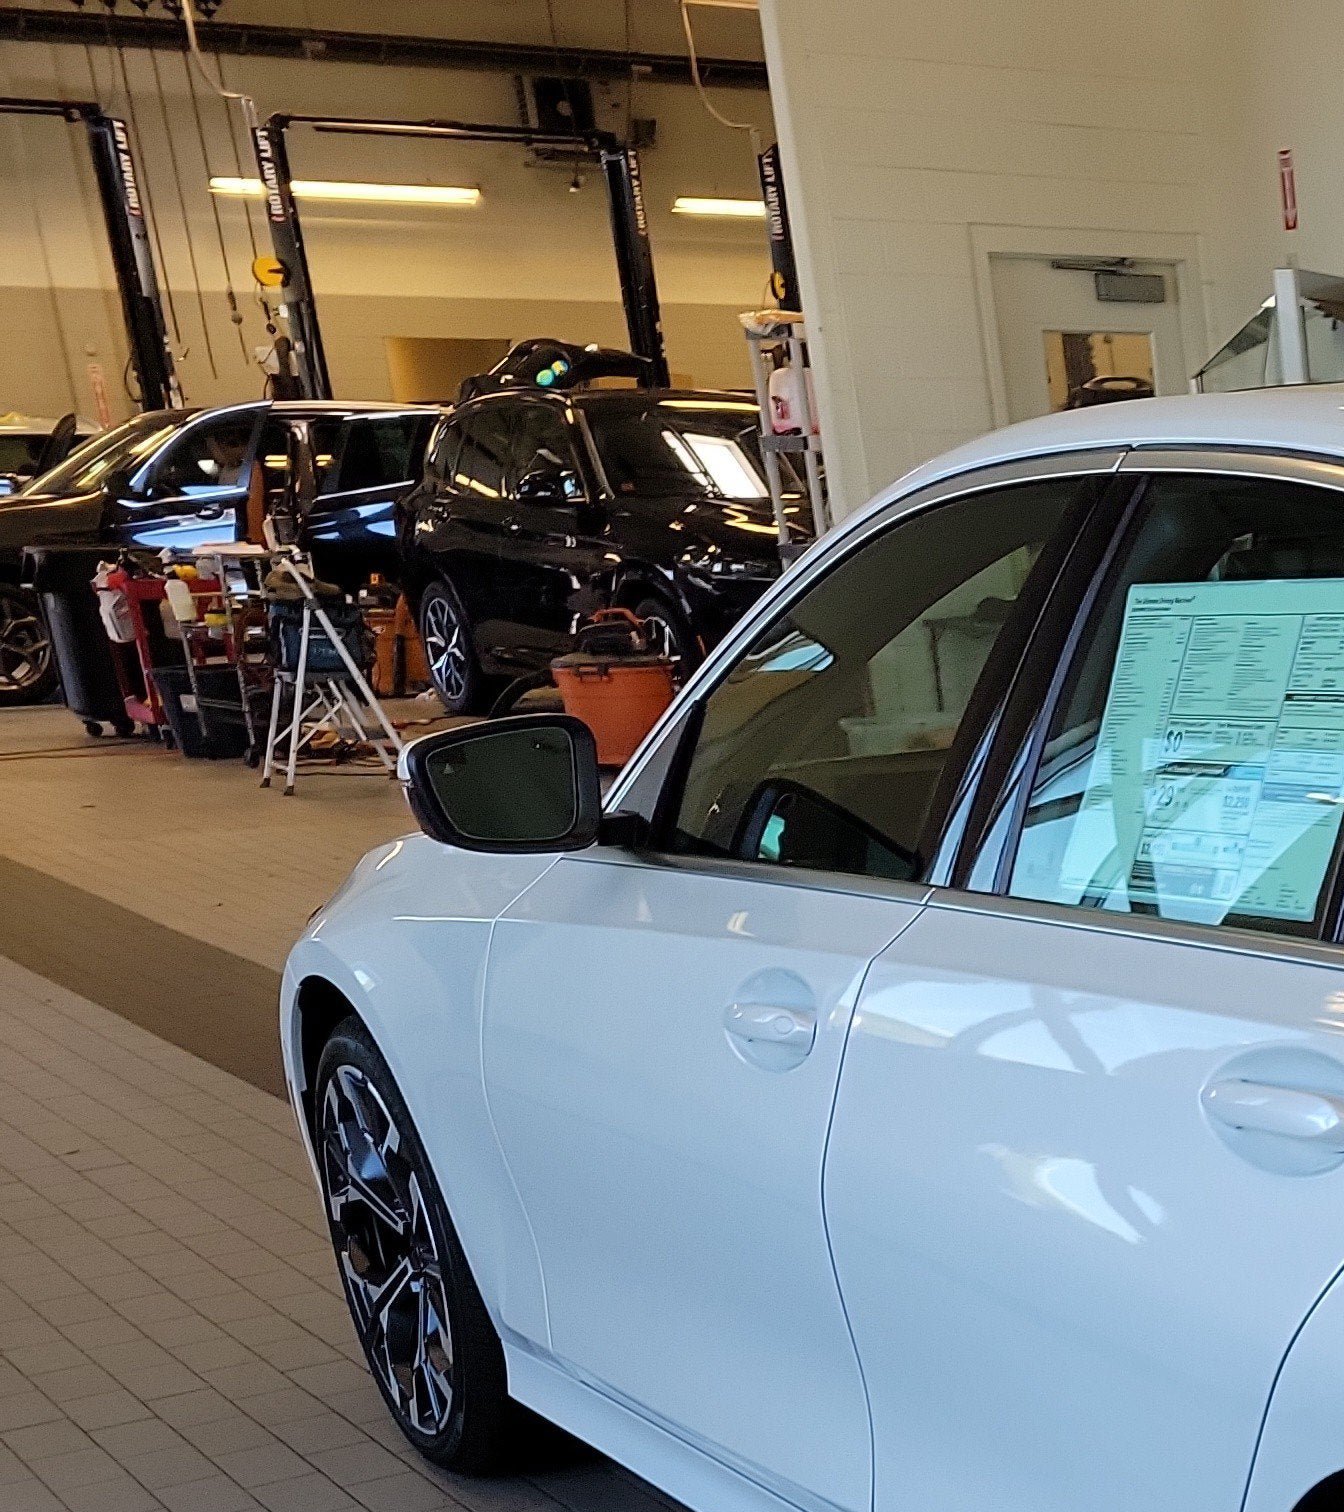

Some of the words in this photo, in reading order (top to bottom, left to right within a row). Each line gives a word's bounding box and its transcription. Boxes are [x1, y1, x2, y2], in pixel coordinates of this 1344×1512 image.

[112, 119, 128, 150] LIFT
[256, 130, 273, 158] LIFT
[118, 151, 140, 210] ROTARY
[261, 160, 284, 215] ROTARY
